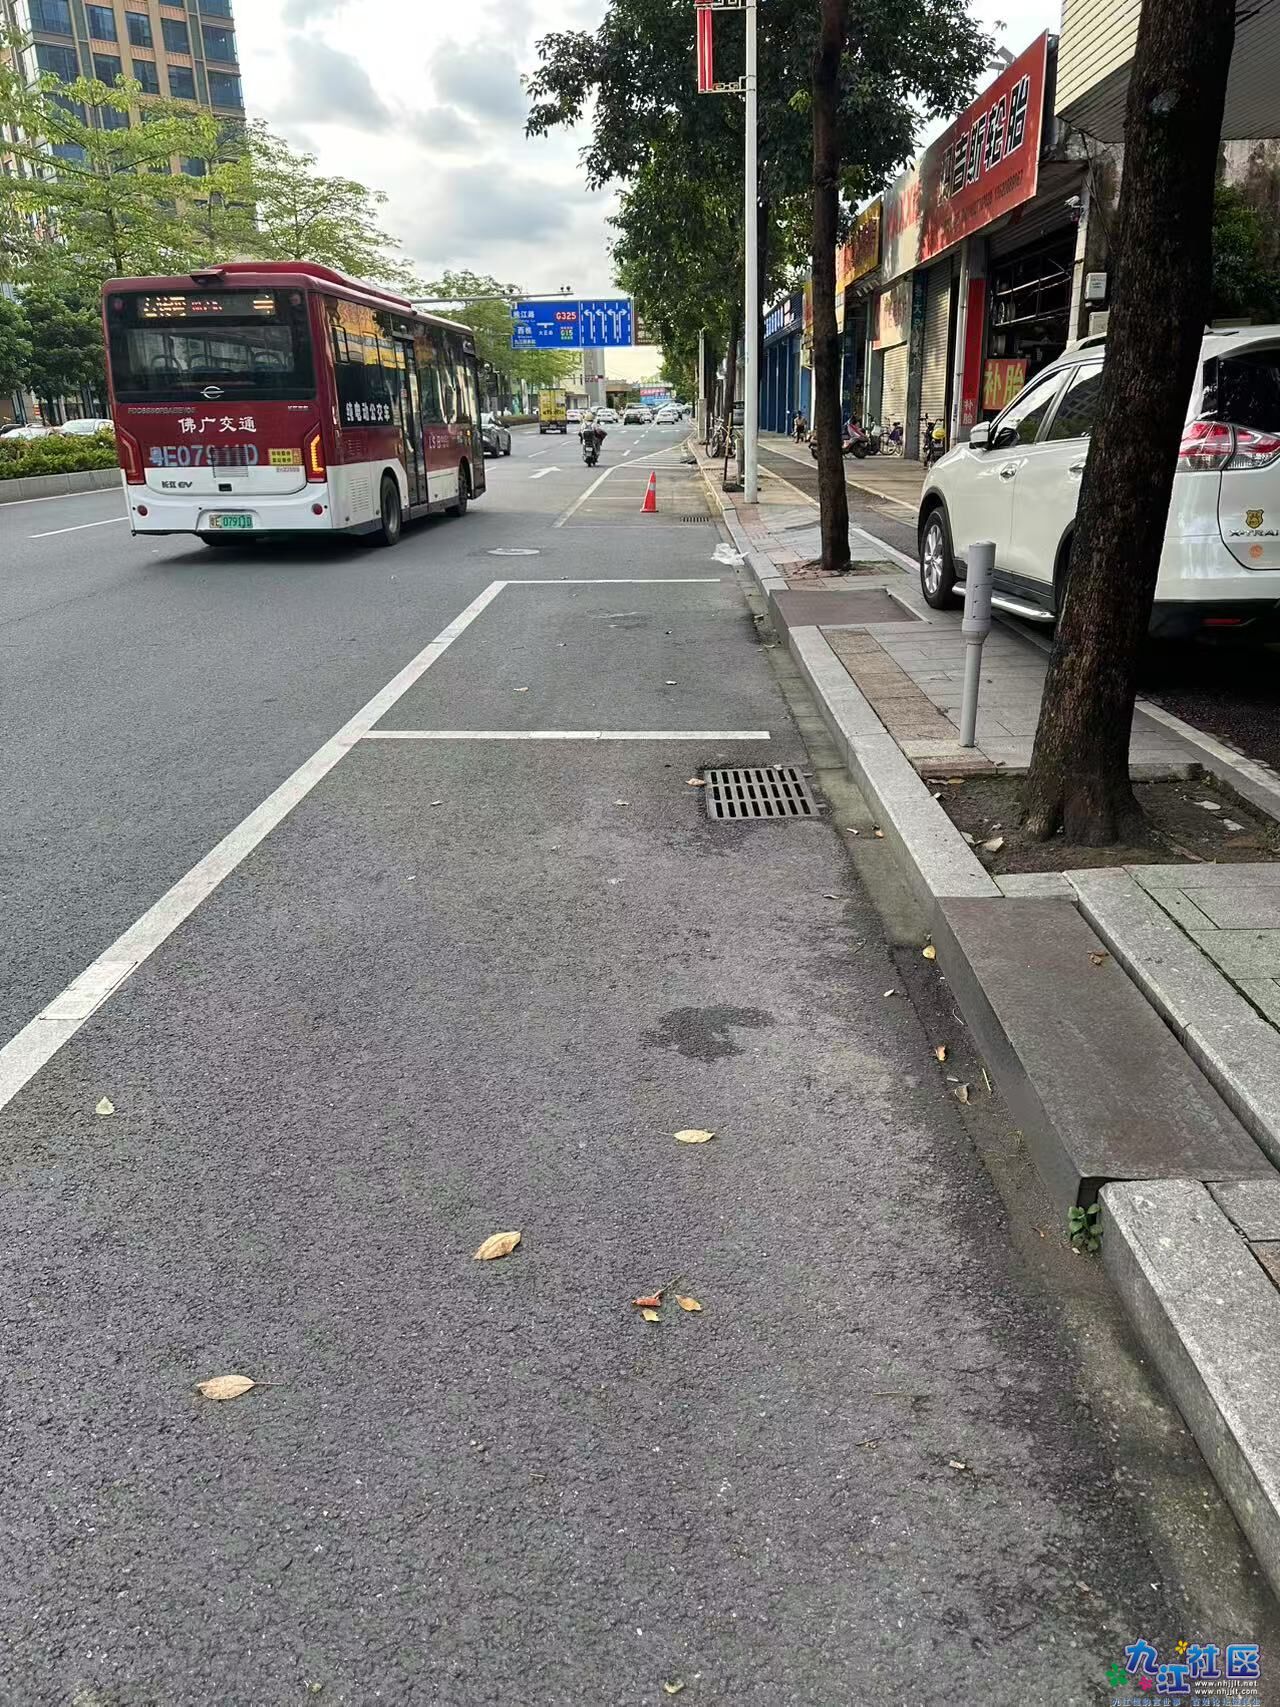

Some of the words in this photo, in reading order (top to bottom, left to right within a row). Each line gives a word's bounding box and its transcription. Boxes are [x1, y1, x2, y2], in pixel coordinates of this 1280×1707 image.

[556, 311, 577, 320] G325
[984, 362, 1025, 406] 补胎
[346, 401, 390, 421] 纯电动公交车
[963, 399, 973, 425] 补胎
[178, 416, 257, 433] 佛广交通
